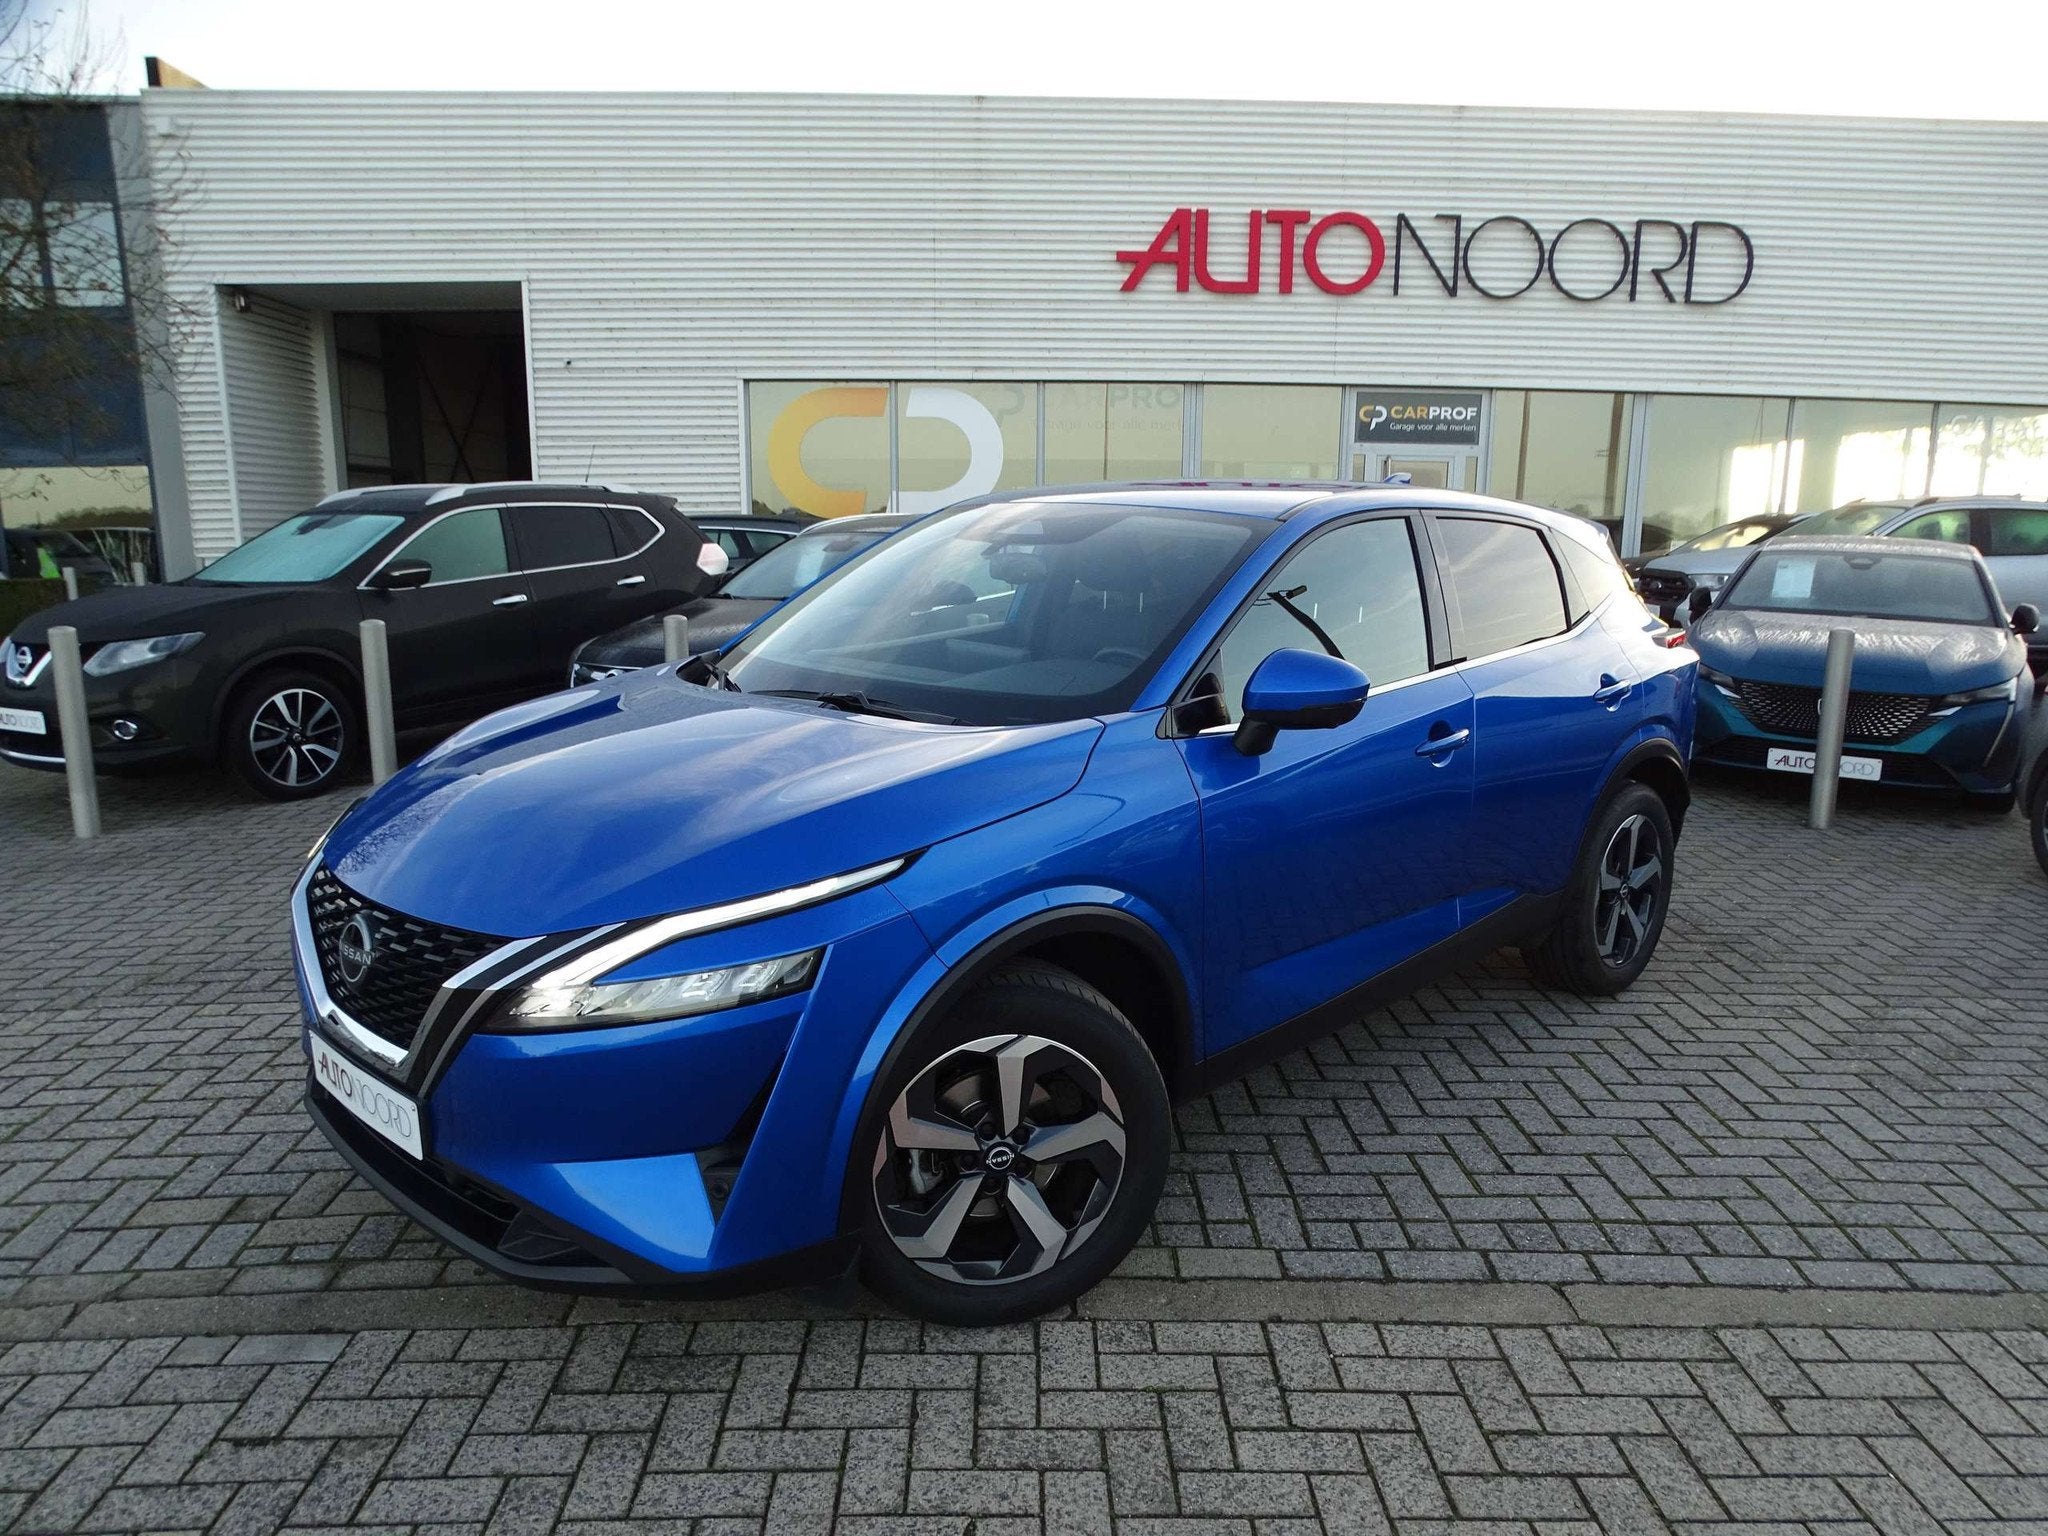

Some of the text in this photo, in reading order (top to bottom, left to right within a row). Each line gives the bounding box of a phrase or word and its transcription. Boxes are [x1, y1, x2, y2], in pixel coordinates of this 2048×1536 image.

[1390, 405, 1478, 420] CARPROF
[1390, 422, 1415, 431] Garage
[1417, 423, 1433, 431] voor
[1435, 423, 1448, 431] alle
[1775, 754, 1874, 775] AUTOORD
